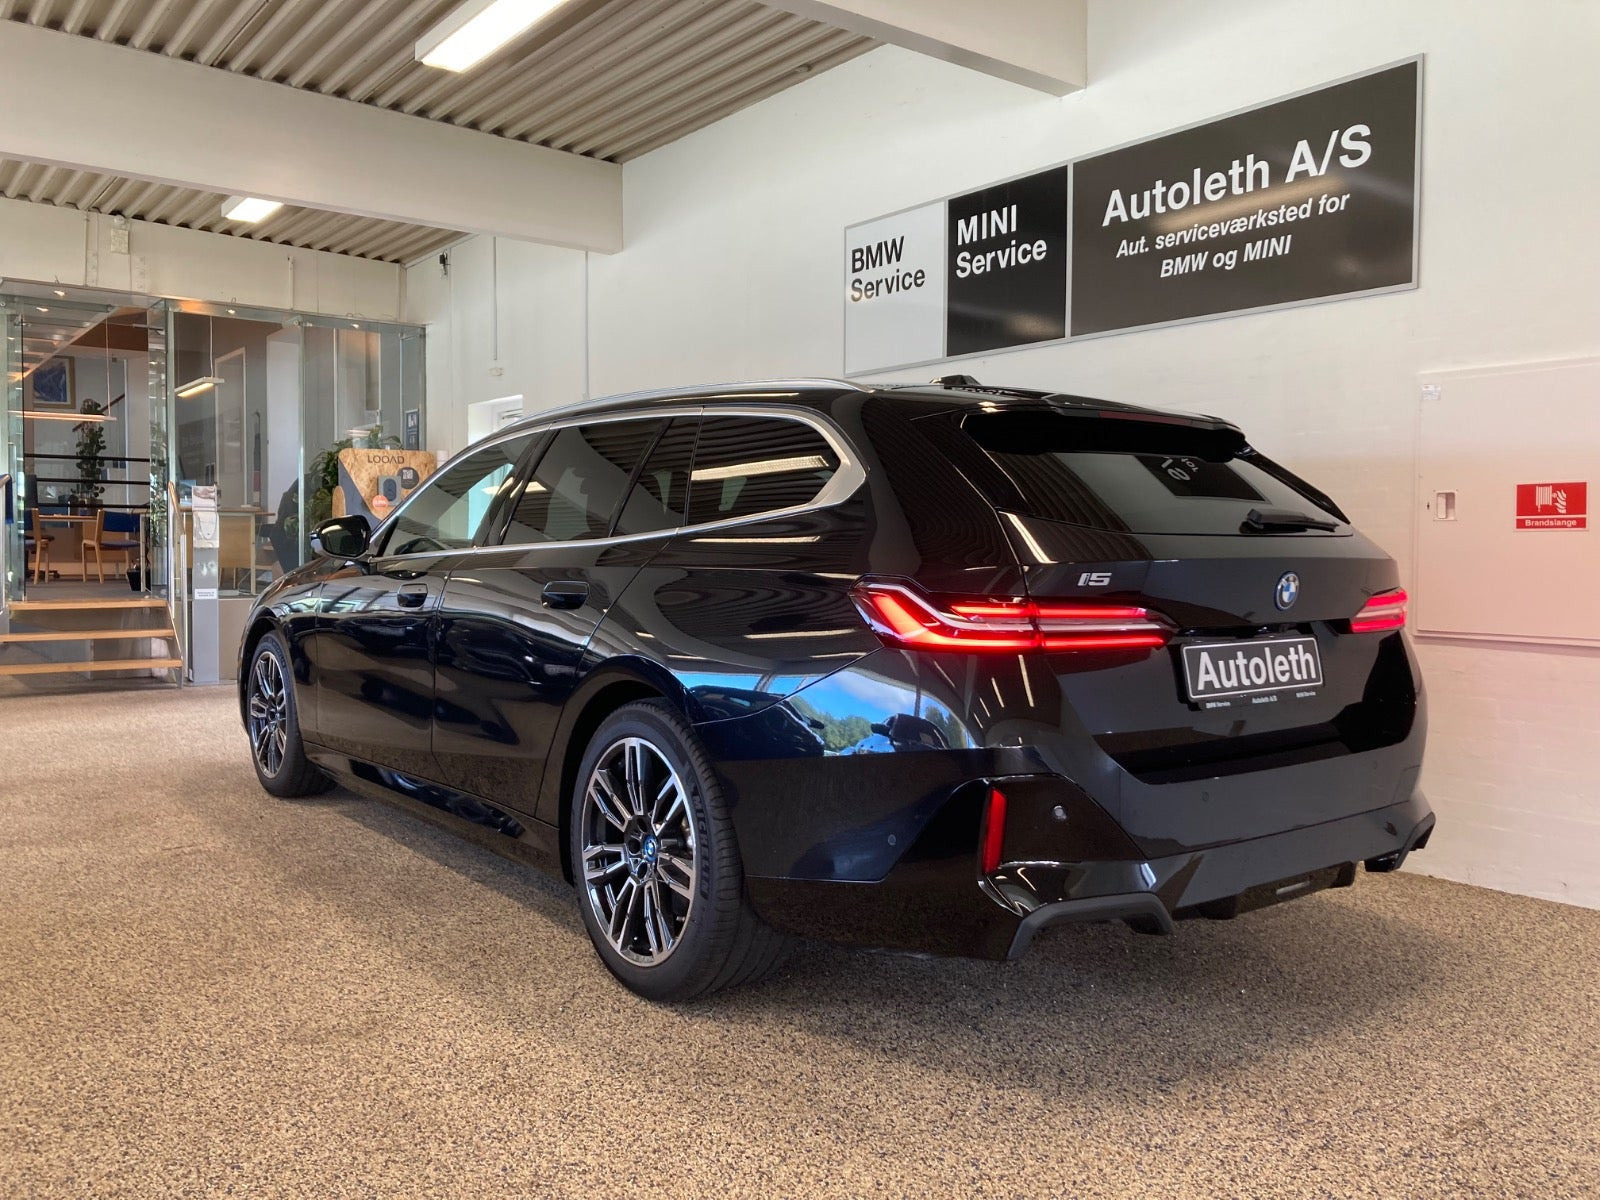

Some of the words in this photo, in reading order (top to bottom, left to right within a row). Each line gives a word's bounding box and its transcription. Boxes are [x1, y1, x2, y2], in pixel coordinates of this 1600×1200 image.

[1102, 153, 1270, 227] Autoleth
[1285, 124, 1372, 183] A/S
[957, 204, 1017, 246] MINI
[1116, 236, 1149, 258] Aut.
[1155, 198, 1312, 250] serviceværksted
[1318, 194, 1350, 215] for
[851, 235, 905, 274] BMW
[956, 239, 1047, 279] Service
[1160, 251, 1208, 278] BMW
[1212, 249, 1238, 270] og
[1243, 234, 1292, 262] MINI
[850, 268, 925, 302] Service
[367, 454, 405, 465] LOOAD
[1525, 518, 1577, 528] Brandslange
[1077, 572, 1112, 586] i5
[1197, 644, 1316, 691] Autoleth
